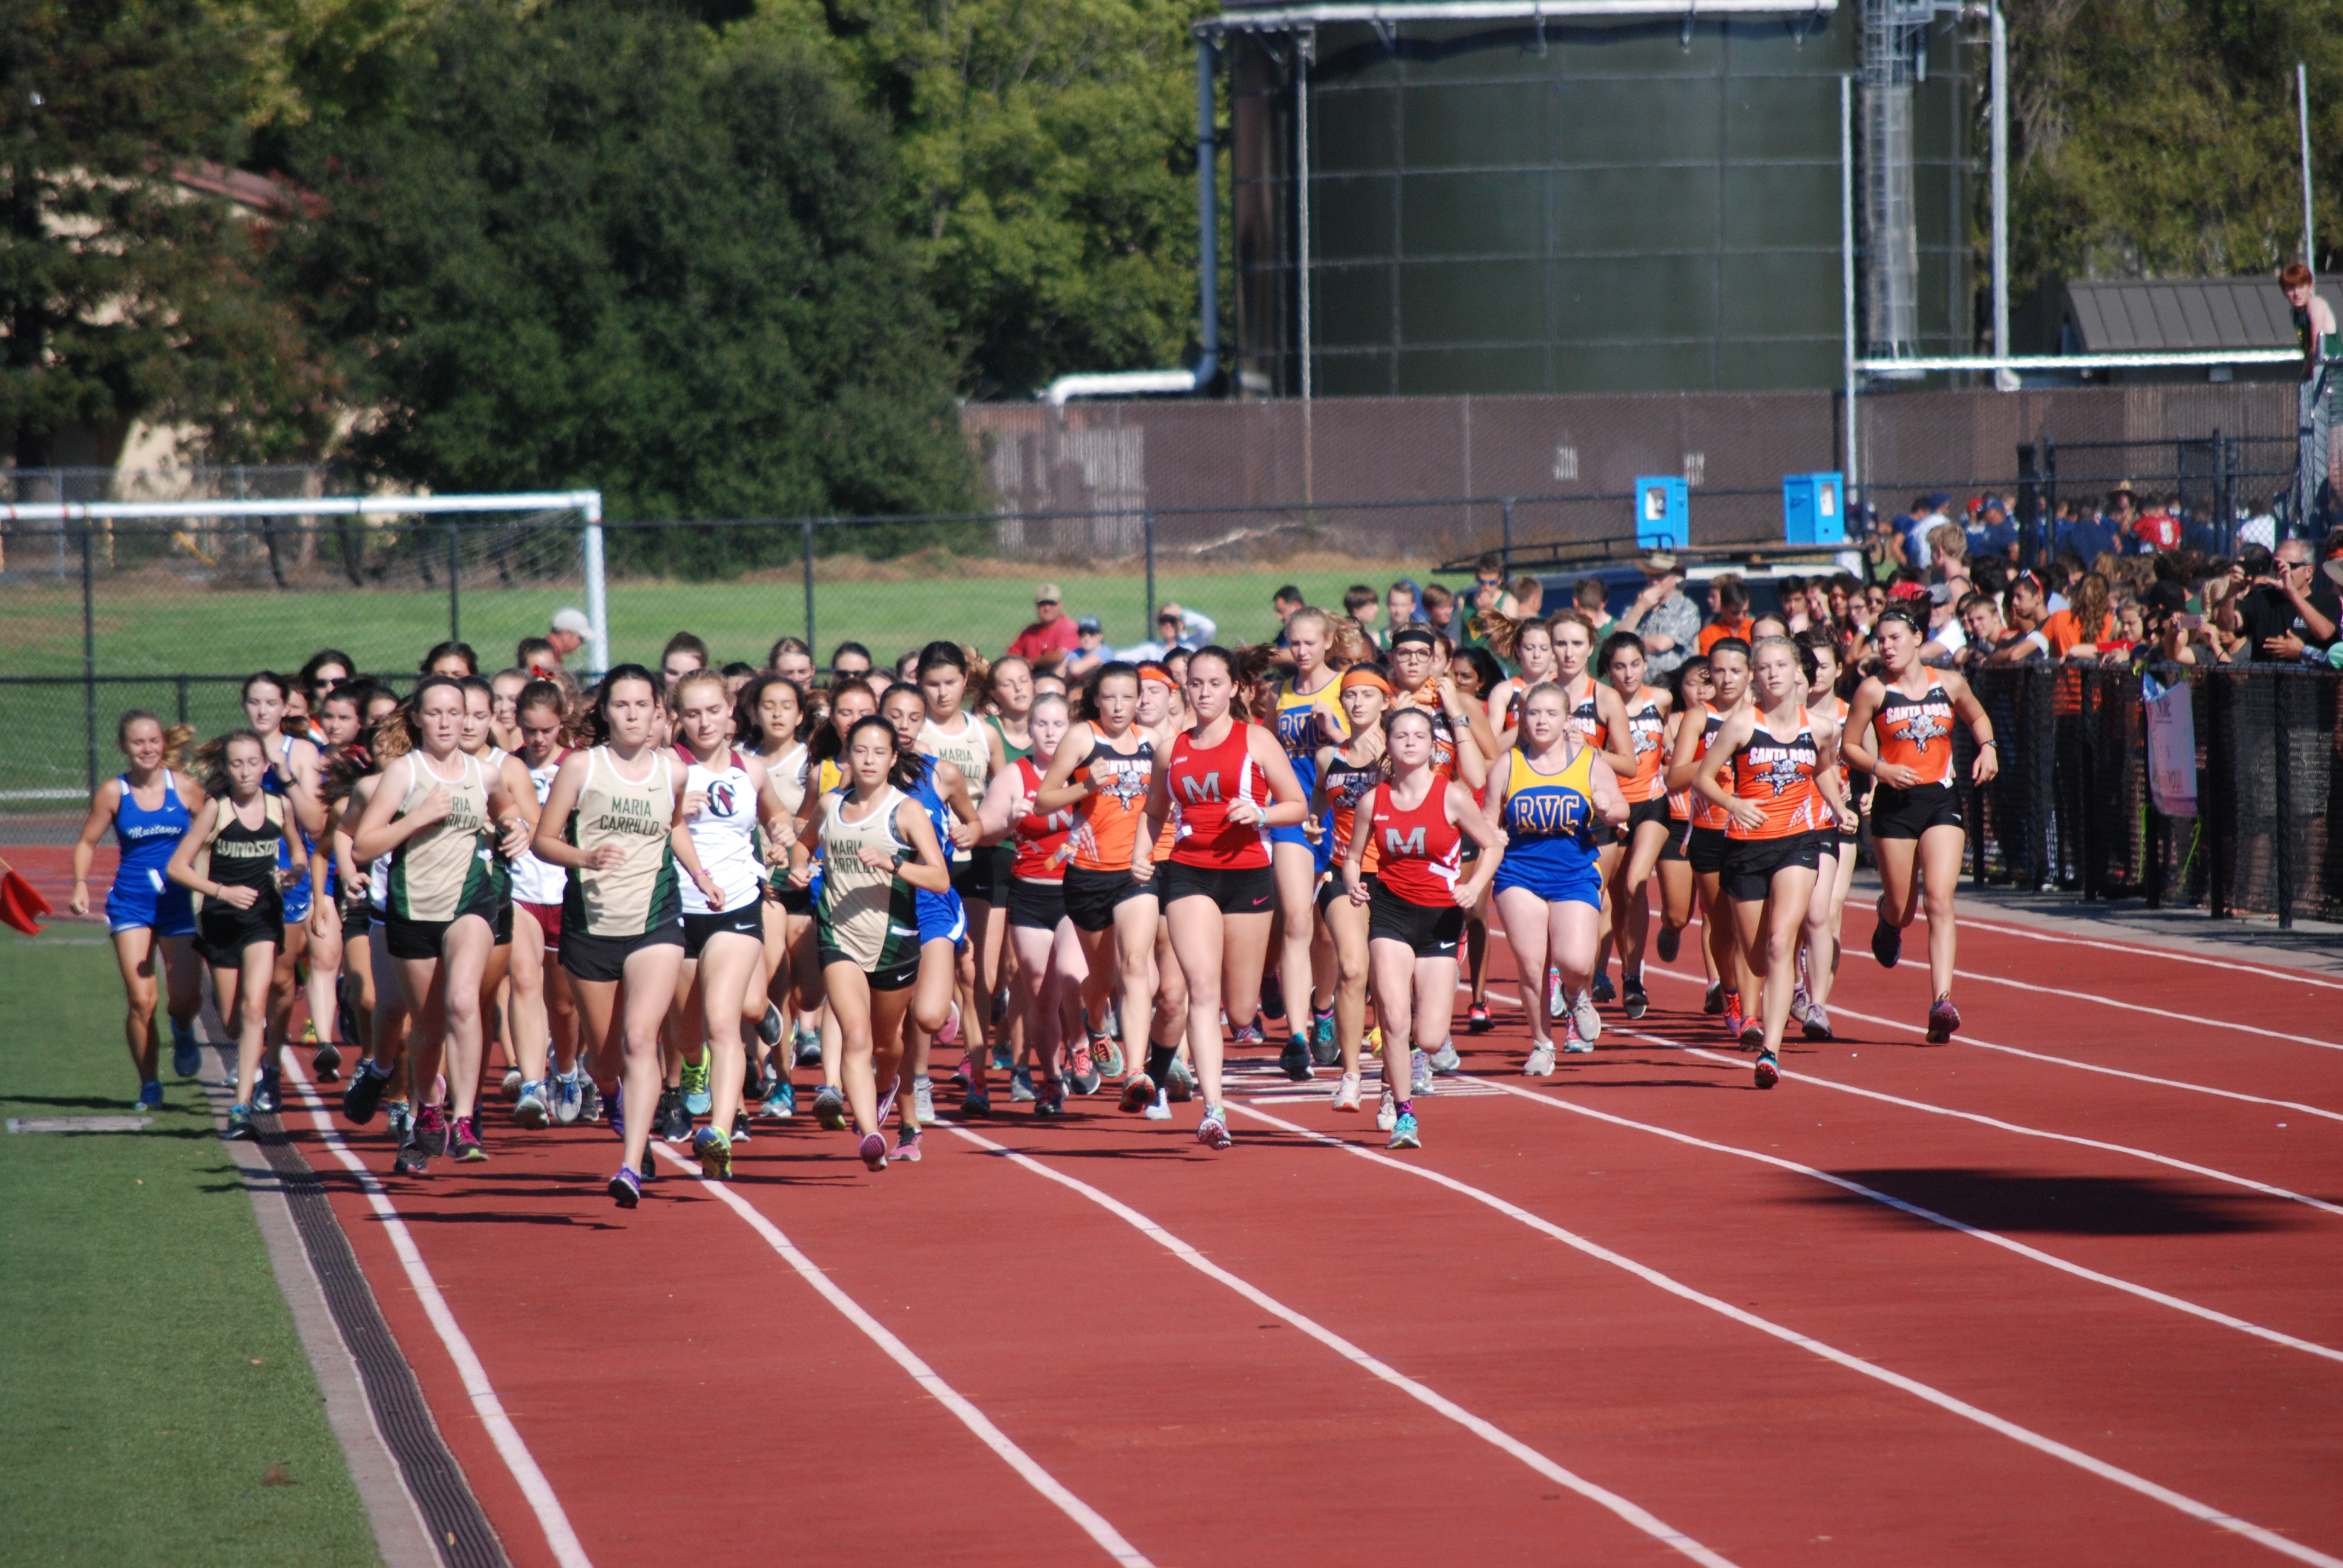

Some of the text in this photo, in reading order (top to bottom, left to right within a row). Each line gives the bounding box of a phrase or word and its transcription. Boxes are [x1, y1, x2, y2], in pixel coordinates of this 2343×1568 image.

[1886, 702, 1953, 725] SANTA ROSA
[1277, 712, 1331, 757] RVC
[939, 748, 974, 762] MARIA
[1748, 746, 1787, 766] SANTA
[1107, 759, 1152, 775] NTA ROS
[1181, 771, 1222, 805] M
[1325, 773, 1358, 791] SANTA
[452, 797, 471, 812] RIA
[612, 796, 652, 817] MARIA
[1515, 795, 1579, 834] RVC
[128, 825, 182, 840] Mustangs
[600, 815, 660, 836] CARRILLO
[217, 837, 281, 860] WINDSOR
[1385, 826, 1427, 857] M
